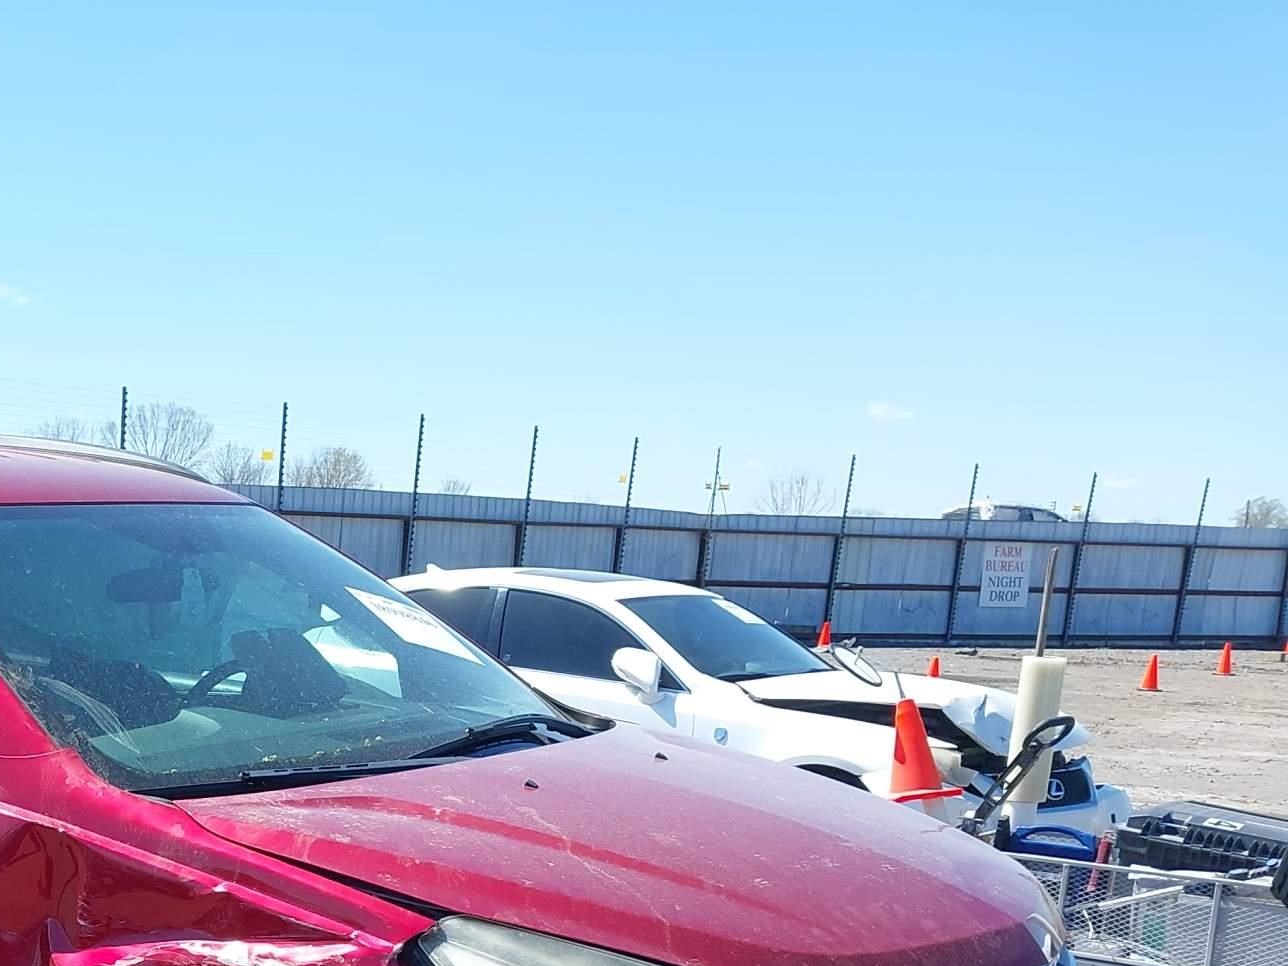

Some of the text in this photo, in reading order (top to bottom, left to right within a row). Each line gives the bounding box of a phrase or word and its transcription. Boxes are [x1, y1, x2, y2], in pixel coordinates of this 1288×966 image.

[994, 545, 1022, 558] FARM
[985, 560, 1026, 573] BUREAU
[988, 576, 1024, 588] NIGHT
[989, 590, 1020, 602] DROP
